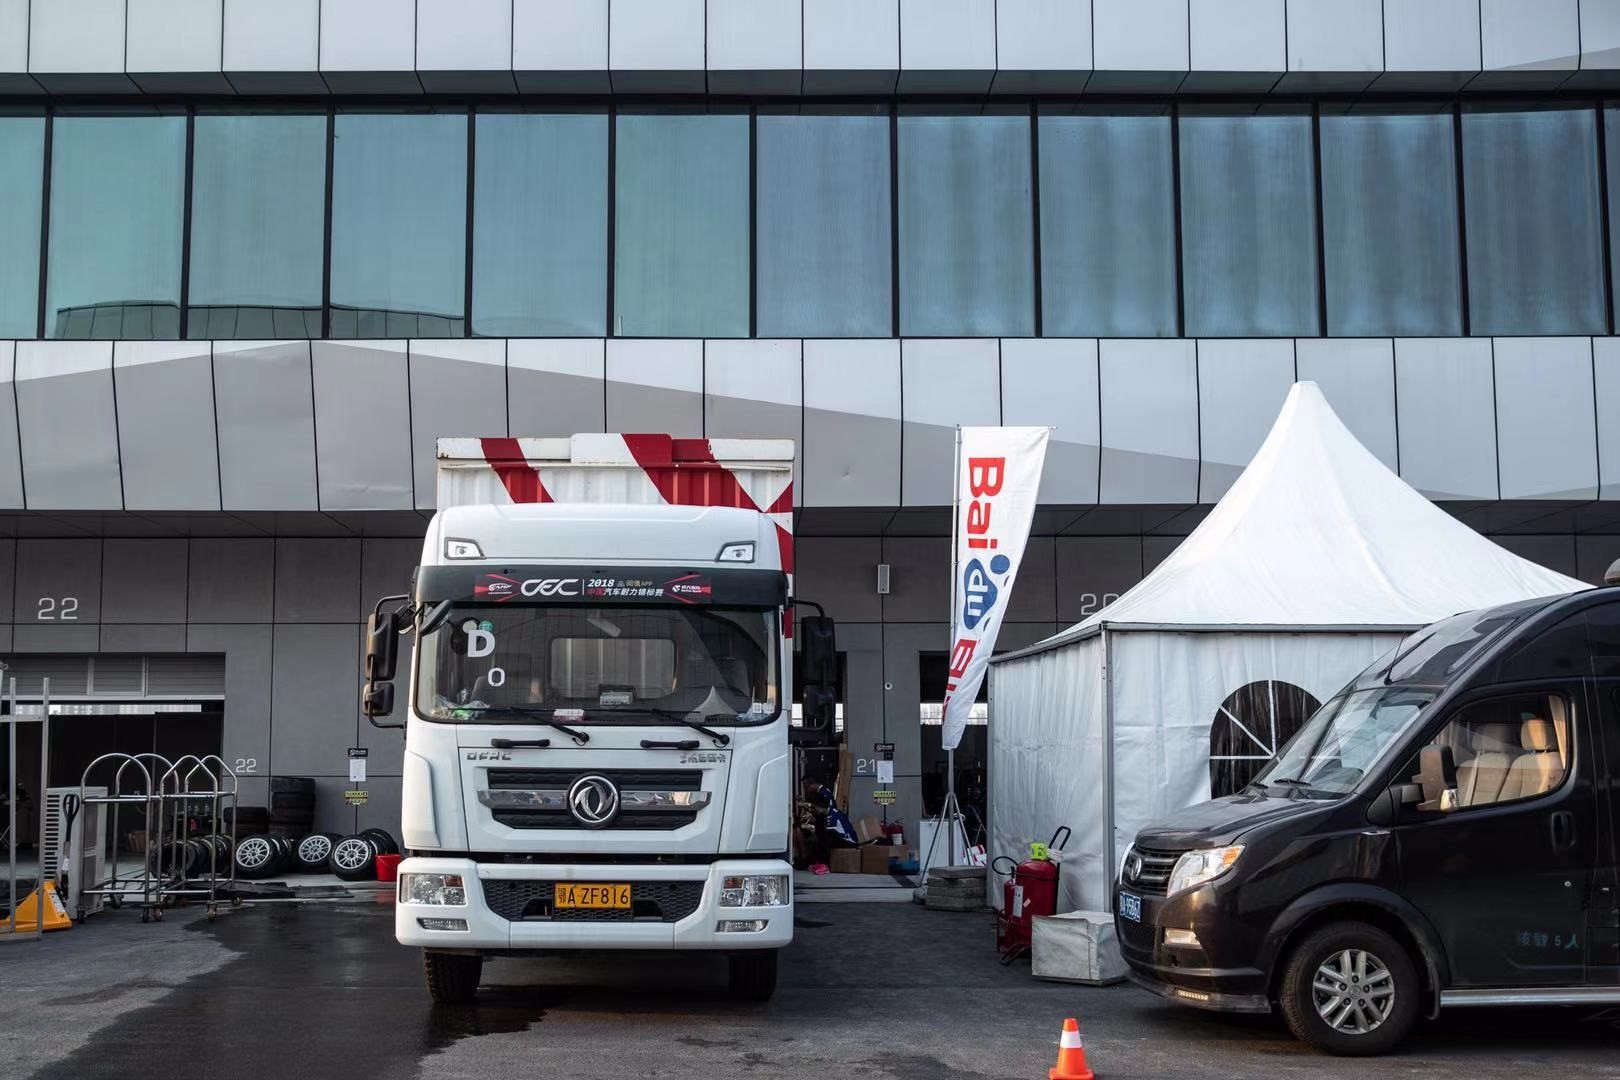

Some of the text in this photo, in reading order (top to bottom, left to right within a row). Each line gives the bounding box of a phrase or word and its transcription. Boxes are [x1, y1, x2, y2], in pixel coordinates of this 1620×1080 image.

[587, 579, 615, 588] 2018
[586, 587, 665, 597] 中国汽车耐力锦标赛
[38, 597, 78, 620] 22
[235, 758, 257, 773] 22
[856, 758, 876, 773] 21
